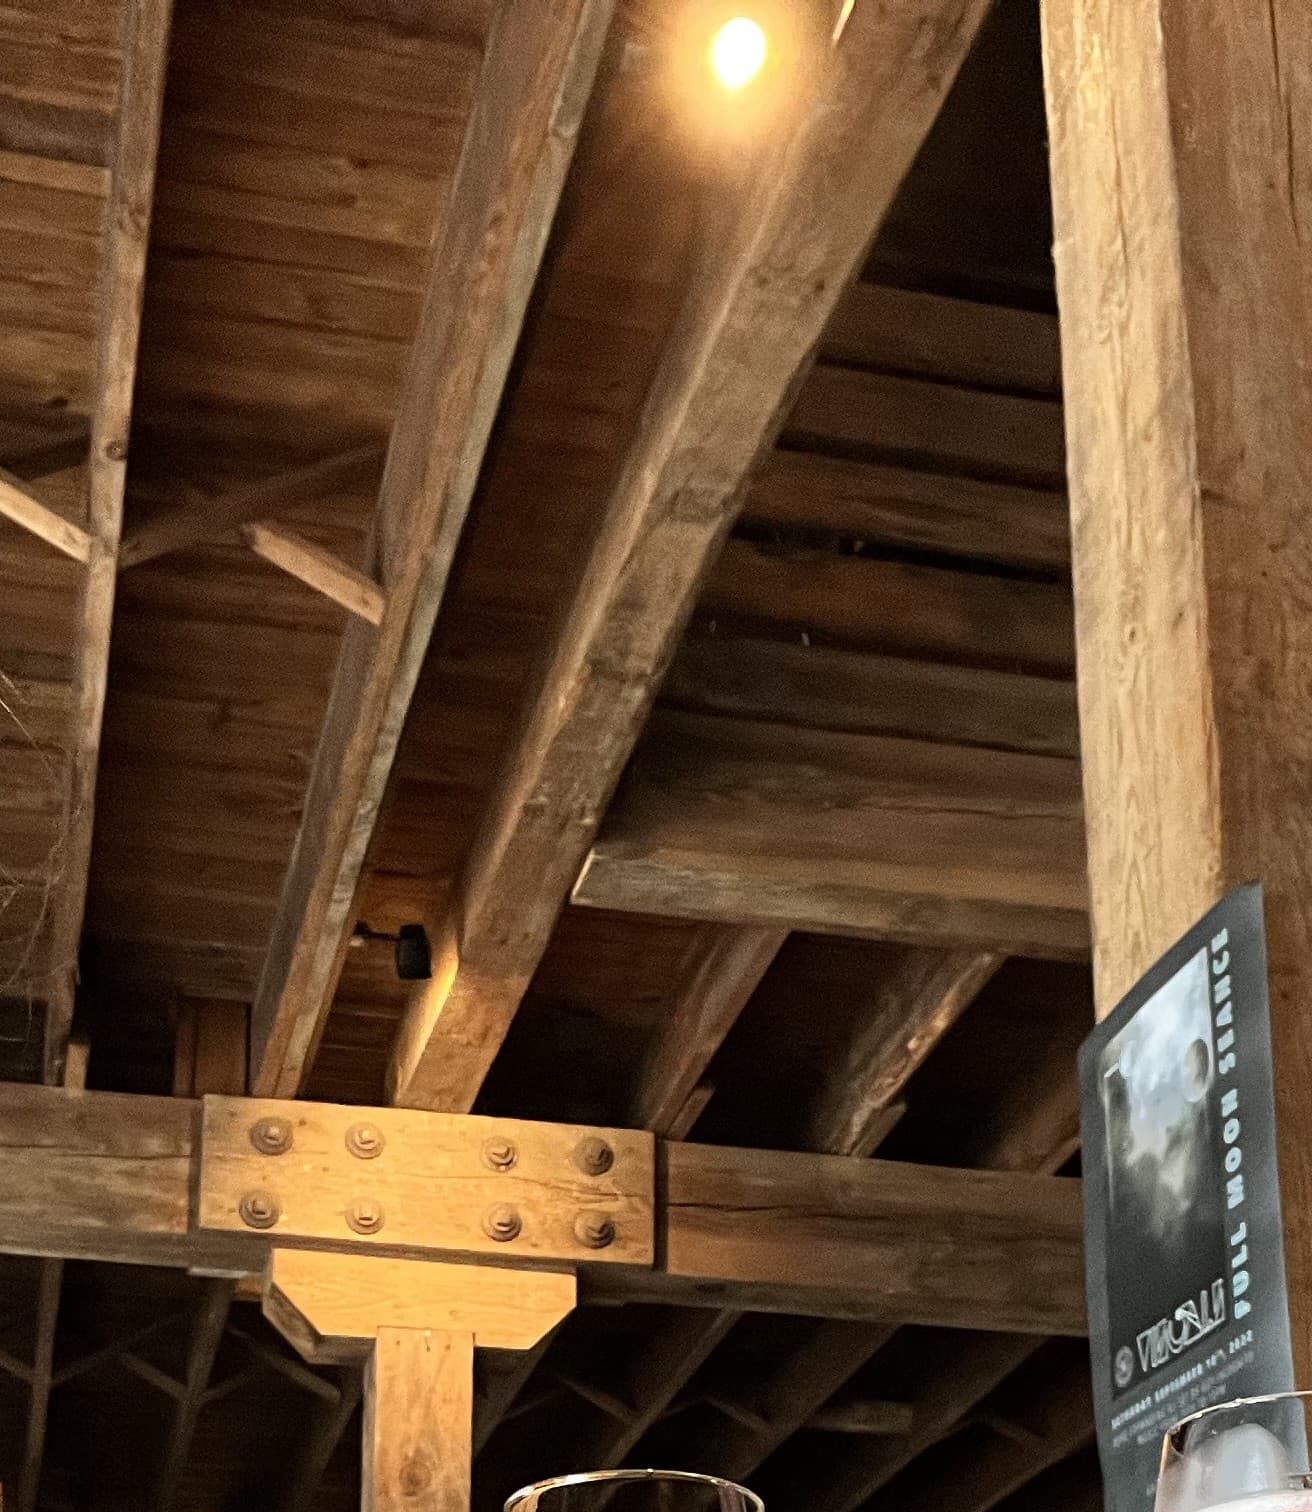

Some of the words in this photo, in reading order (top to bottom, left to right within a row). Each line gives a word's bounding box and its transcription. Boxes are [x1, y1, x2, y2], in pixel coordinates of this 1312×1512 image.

[1211, 927, 1237, 1075] SEANCE
[1221, 1089, 1245, 1209] MOON
[1230, 1222, 1251, 1319] FULL
